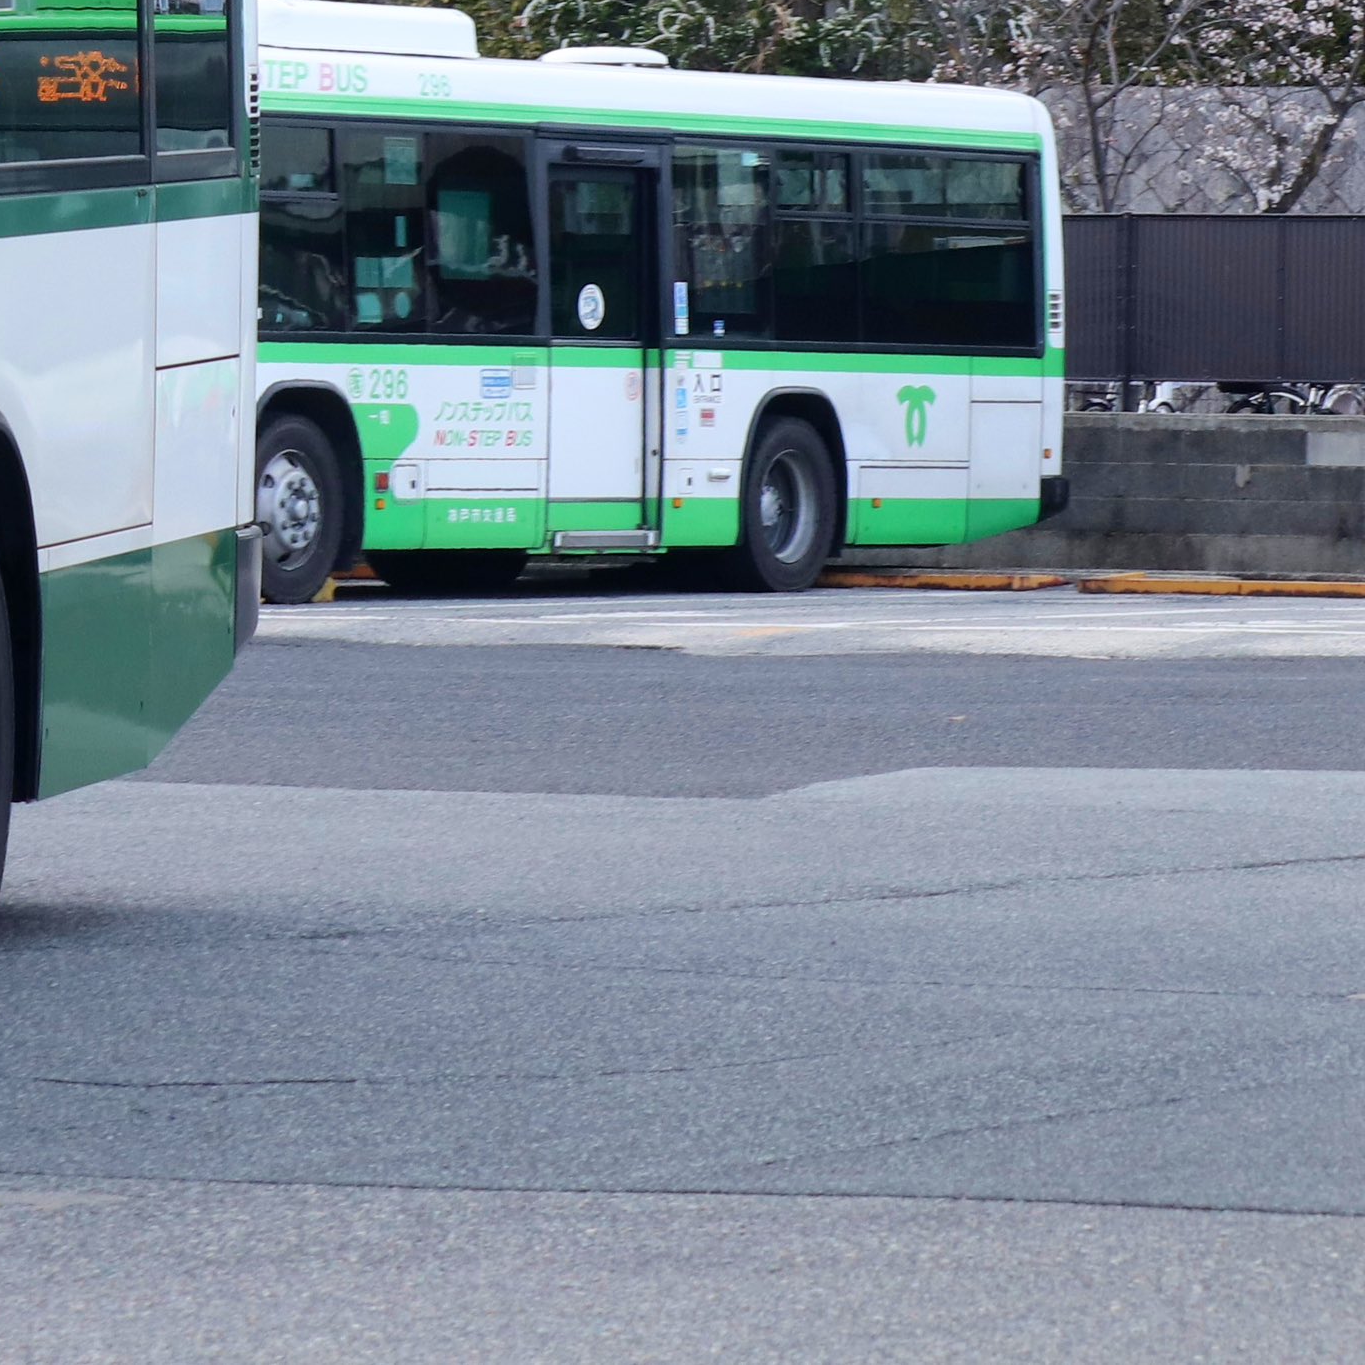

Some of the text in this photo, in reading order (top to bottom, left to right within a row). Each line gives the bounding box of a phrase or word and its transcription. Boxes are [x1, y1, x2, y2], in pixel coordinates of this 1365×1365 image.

[318, 62, 368, 92] BUS
[369, 368, 409, 399] 296
[692, 373, 723, 393] 入口
[434, 402, 534, 422] ノンステップバス
[434, 429, 534, 447] NON-STEP BUS
